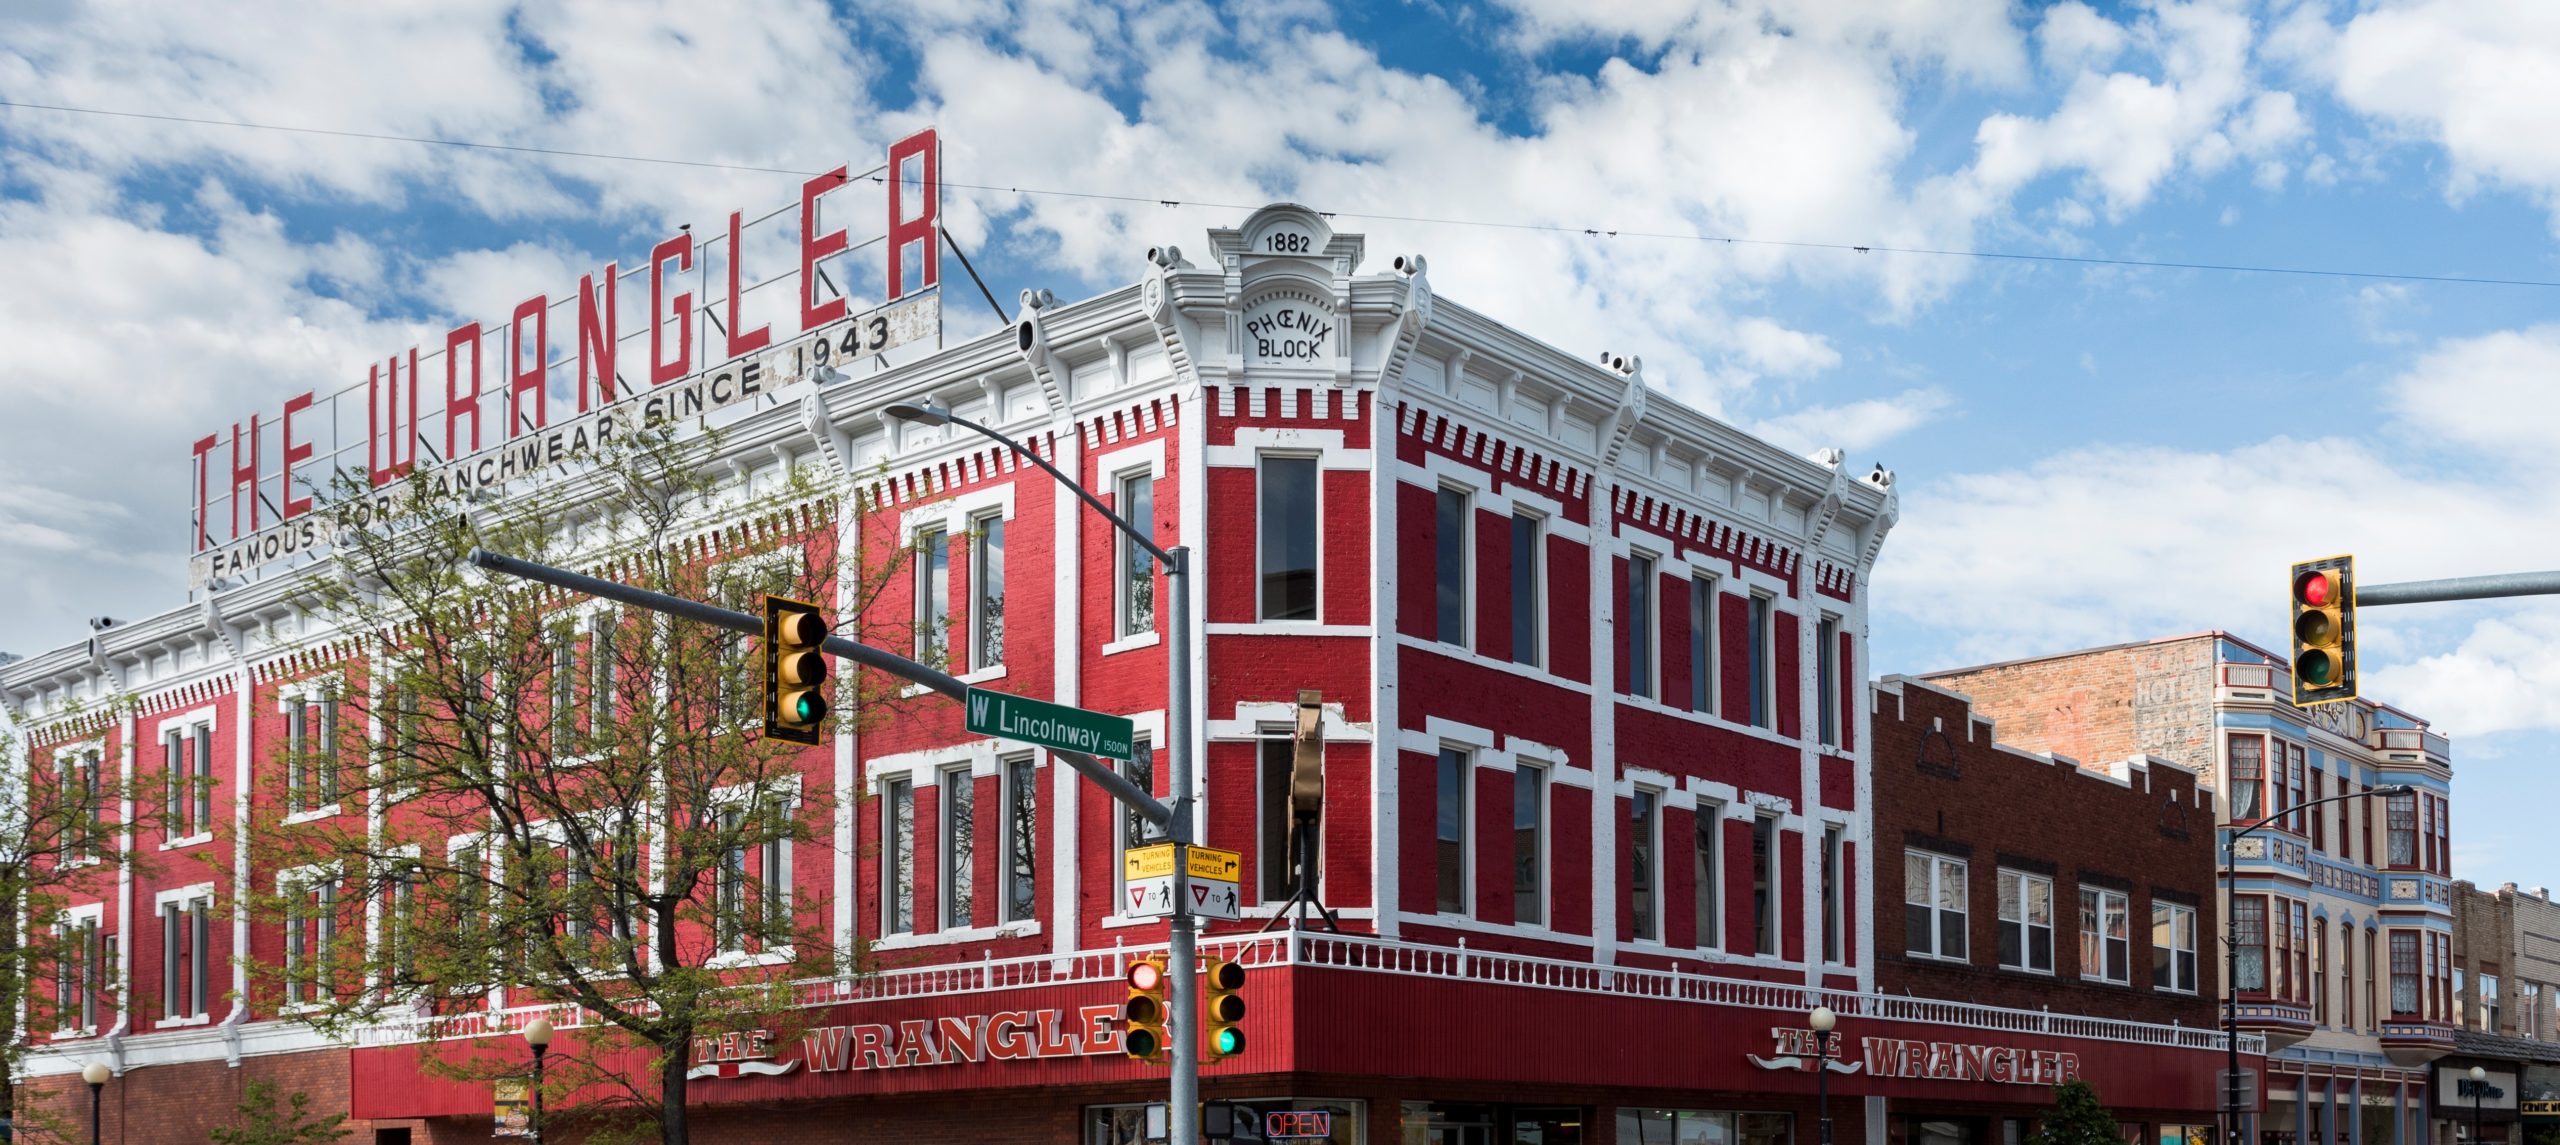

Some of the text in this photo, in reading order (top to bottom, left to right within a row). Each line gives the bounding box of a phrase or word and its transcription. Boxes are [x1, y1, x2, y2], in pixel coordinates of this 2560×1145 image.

[1266, 232, 1310, 252] 1882
[192, 126, 940, 553] THE WRANGLER
[1258, 338, 1320, 358] BLOCK
[213, 521, 315, 578] FAMOUS
[338, 496, 391, 531] FOR
[644, 362, 761, 430] SINCE
[797, 316, 889, 377] 1943
[972, 694, 1128, 754] W Lincolnway 1500N
[1142, 849, 1170, 860] TURNING
[1191, 850, 1222, 862] TURNING
[1141, 861, 1171, 873] VEHICLES
[1189, 863, 1223, 875] VEHICLES
[1148, 892, 1157, 900] TO
[1211, 894, 1221, 903] TO
[693, 1002, 1172, 1073] THE WRANGLE
[1773, 1027, 2081, 1085] THE WRANGLER
[1268, 1112, 1329, 1136] OPEN
